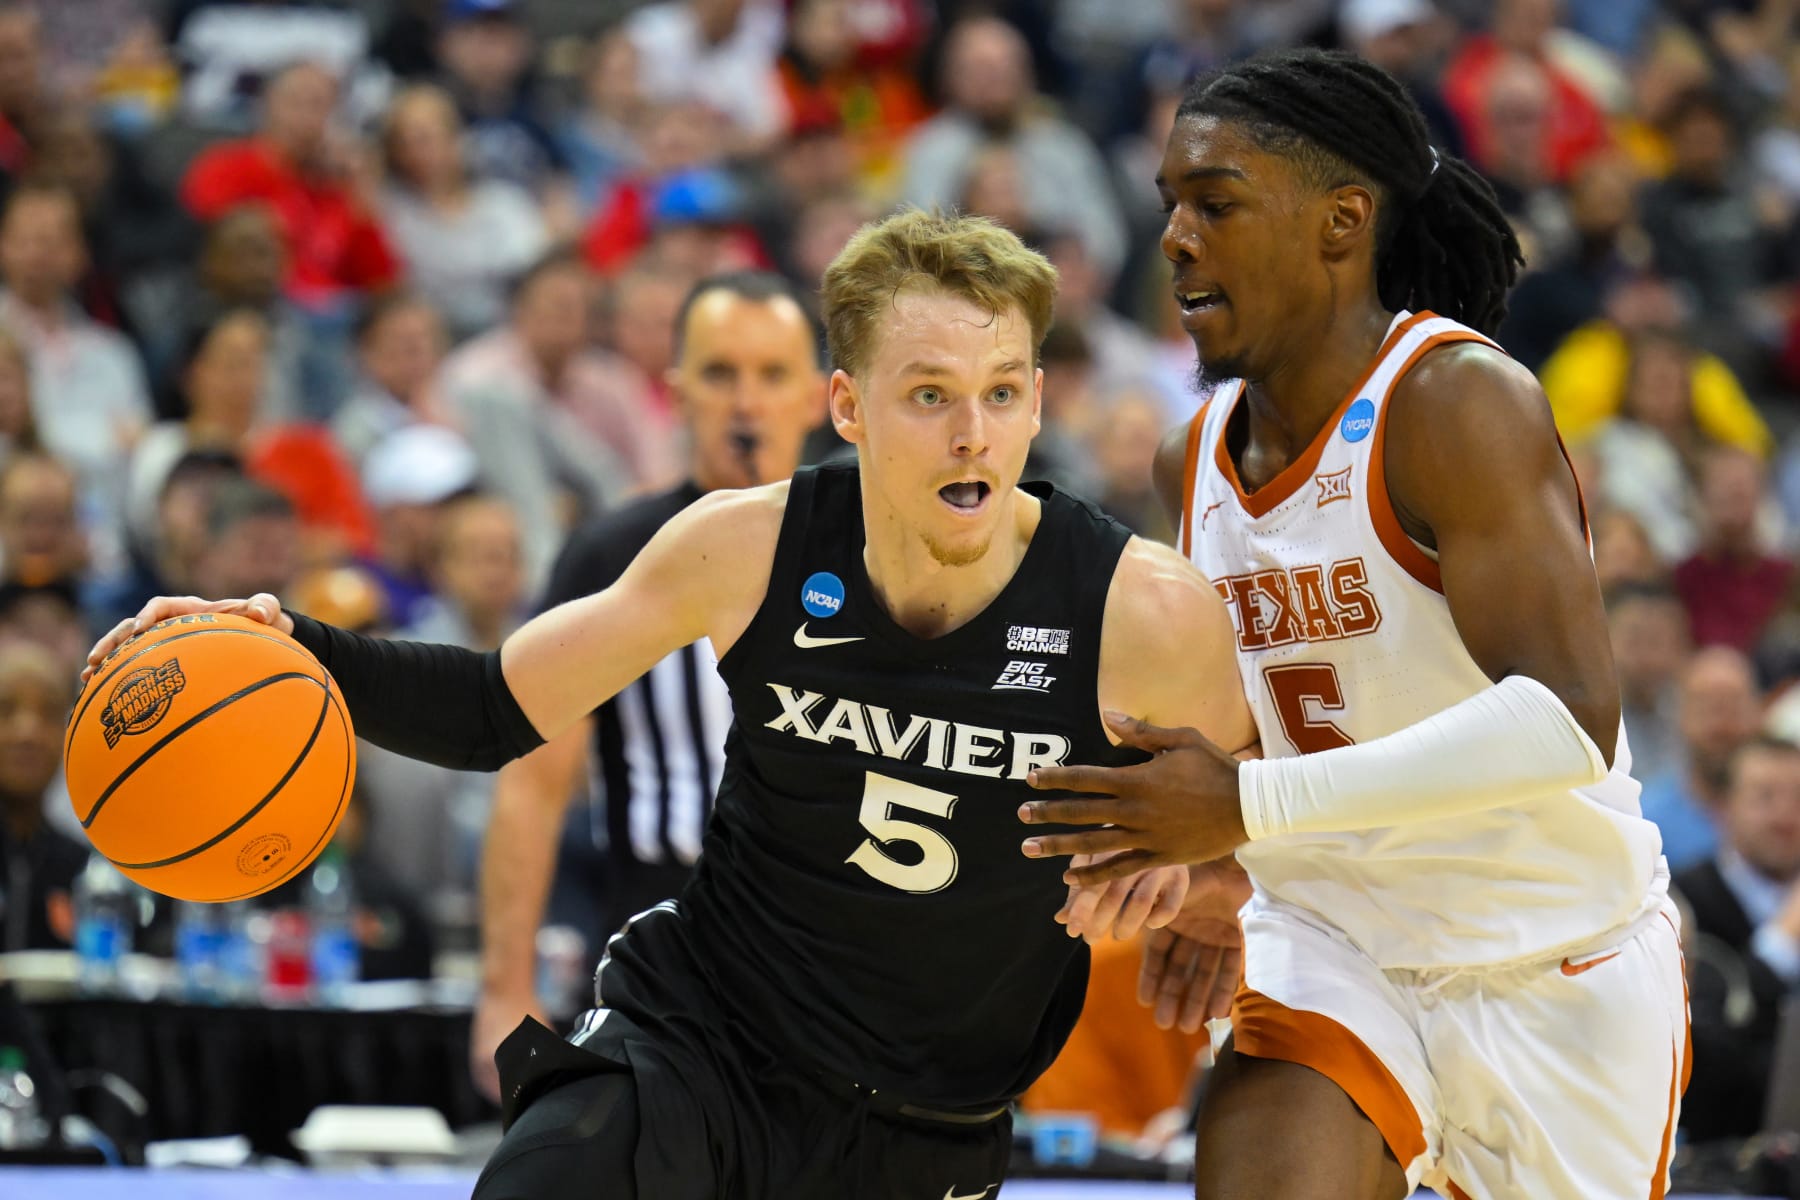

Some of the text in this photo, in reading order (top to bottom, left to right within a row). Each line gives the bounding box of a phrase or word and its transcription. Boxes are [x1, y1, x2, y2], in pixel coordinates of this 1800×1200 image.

[1345, 418, 1372, 431] NCAA
[805, 589, 841, 610] NCAA
[1006, 640, 1069, 654] CHANGE
[1003, 660, 1048, 675] BIG
[996, 672, 1057, 688] EAST
[111, 673, 156, 717] MARCH
[121, 672, 185, 726] MADNESS
[763, 682, 1072, 780] XAVIER
[844, 770, 960, 895] 5
